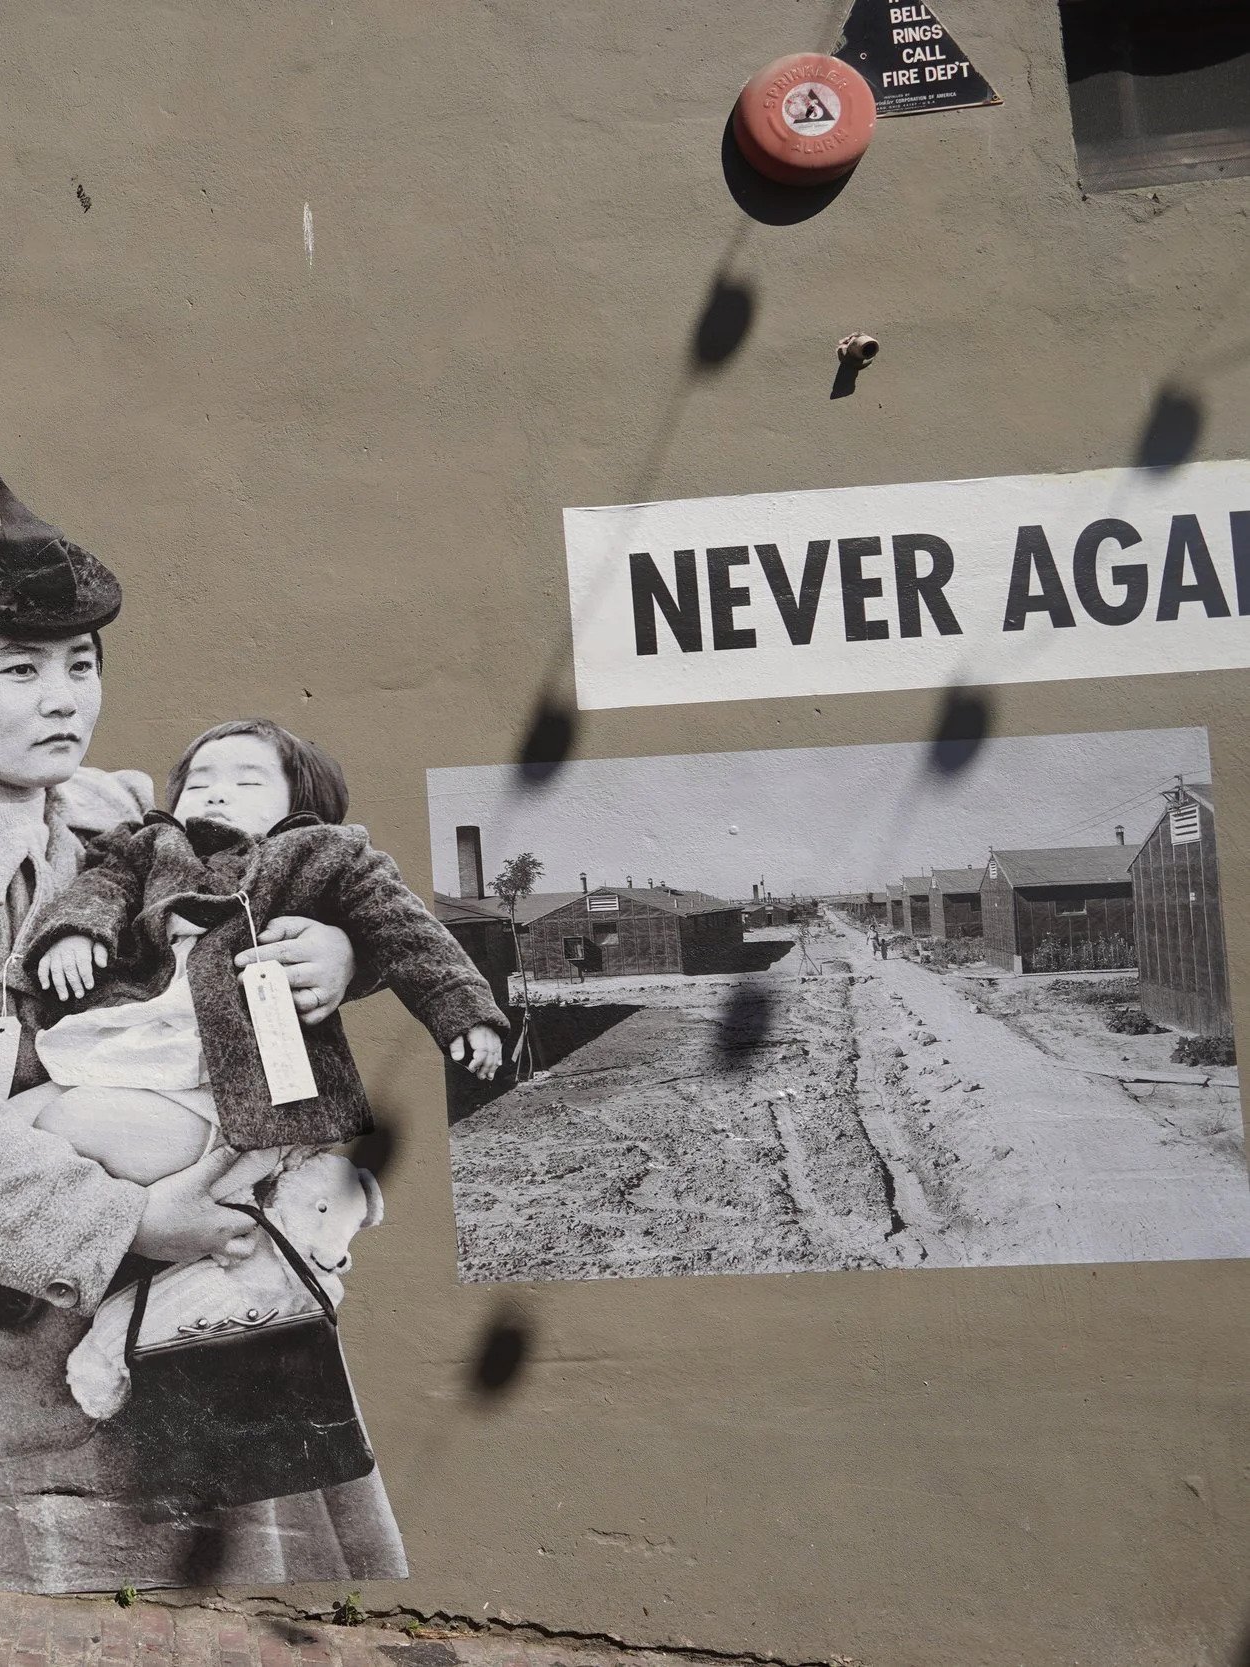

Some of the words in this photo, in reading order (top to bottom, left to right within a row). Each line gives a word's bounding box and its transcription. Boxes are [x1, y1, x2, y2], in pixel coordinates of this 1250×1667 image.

[889, 4, 931, 24] BELL
[892, 24, 943, 44] RINGS
[902, 45, 946, 64] CALL
[763, 64, 848, 110] SPRINKLER
[882, 68, 920, 88] FIRE
[925, 61, 970, 83] DEP'T
[791, 128, 849, 154] ALARM
[629, 532, 963, 656] NEVER
